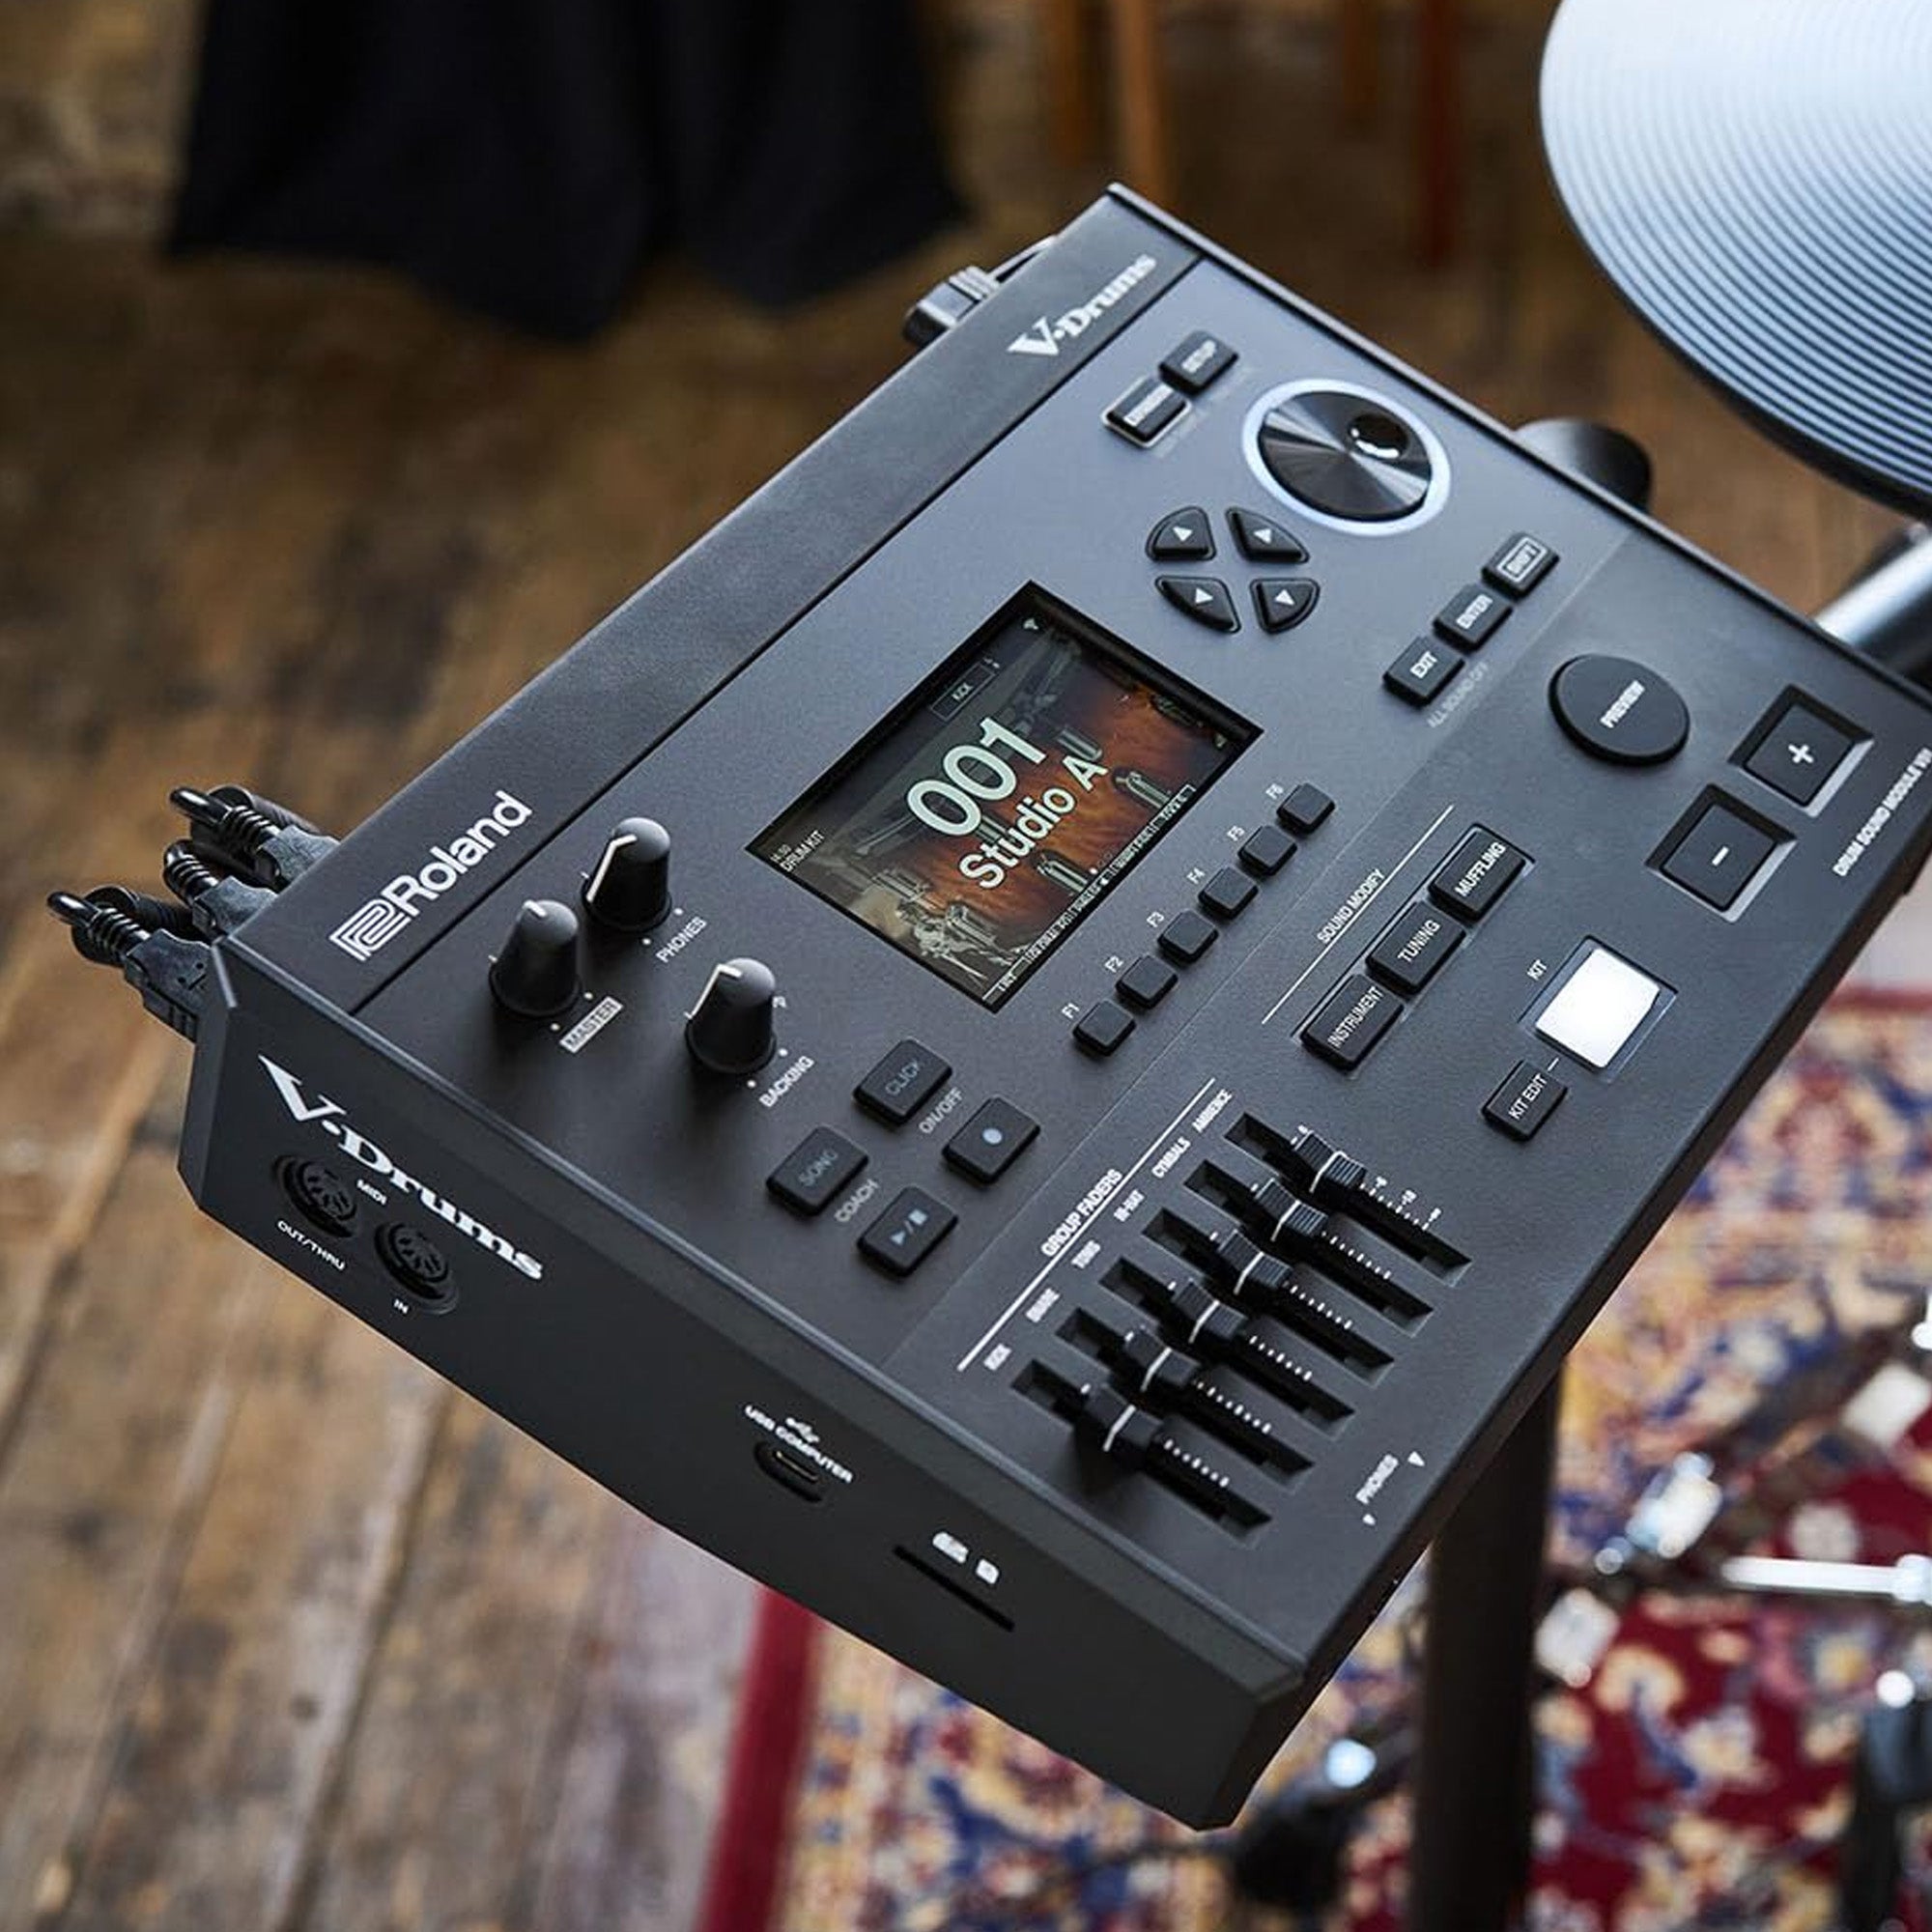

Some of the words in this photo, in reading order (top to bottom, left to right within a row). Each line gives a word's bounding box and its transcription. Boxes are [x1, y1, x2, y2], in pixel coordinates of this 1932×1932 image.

[1410, 650, 1438, 679] EXIT
[907, 717, 1047, 837] 001
[1265, 782, 1285, 800] F6
[805, 830, 825, 849] KIT
[959, 787, 1076, 890] Studio
[1063, 753, 1108, 792] A
[1227, 825, 1245, 841] F5
[381, 790, 533, 917] Roland
[1454, 841, 1506, 897] MUFFLING
[1186, 867, 1207, 885] F4
[1147, 911, 1165, 928] F3
[1317, 906, 1353, 944] SOUND
[1349, 868, 1385, 914] MODIFY
[656, 917, 706, 963] PHONES
[1398, 920, 1440, 963] TUNING
[1104, 955, 1123, 973] F2
[1526, 958, 1548, 981] KIT
[564, 999, 619, 1050] MASTER
[1062, 1002, 1080, 1019] F1
[1327, 986, 1384, 1048] INSTRUMENT
[759, 1056, 814, 1107] BACKING
[1508, 1097, 1529, 1121] KIT
[1522, 1072, 1548, 1102] EDIT
[919, 1087, 964, 1134] ON/OFF
[1151, 1136, 1191, 1179] CYMBALS
[356, 1179, 387, 1206] MIDI
[835, 1179, 879, 1223] COACH
[1040, 1210, 1082, 1257] GROUP
[1076, 1169, 1122, 1217] FADERS
[276, 1219, 347, 1271] OUT/THRU
[393, 1298, 410, 1315] IN
